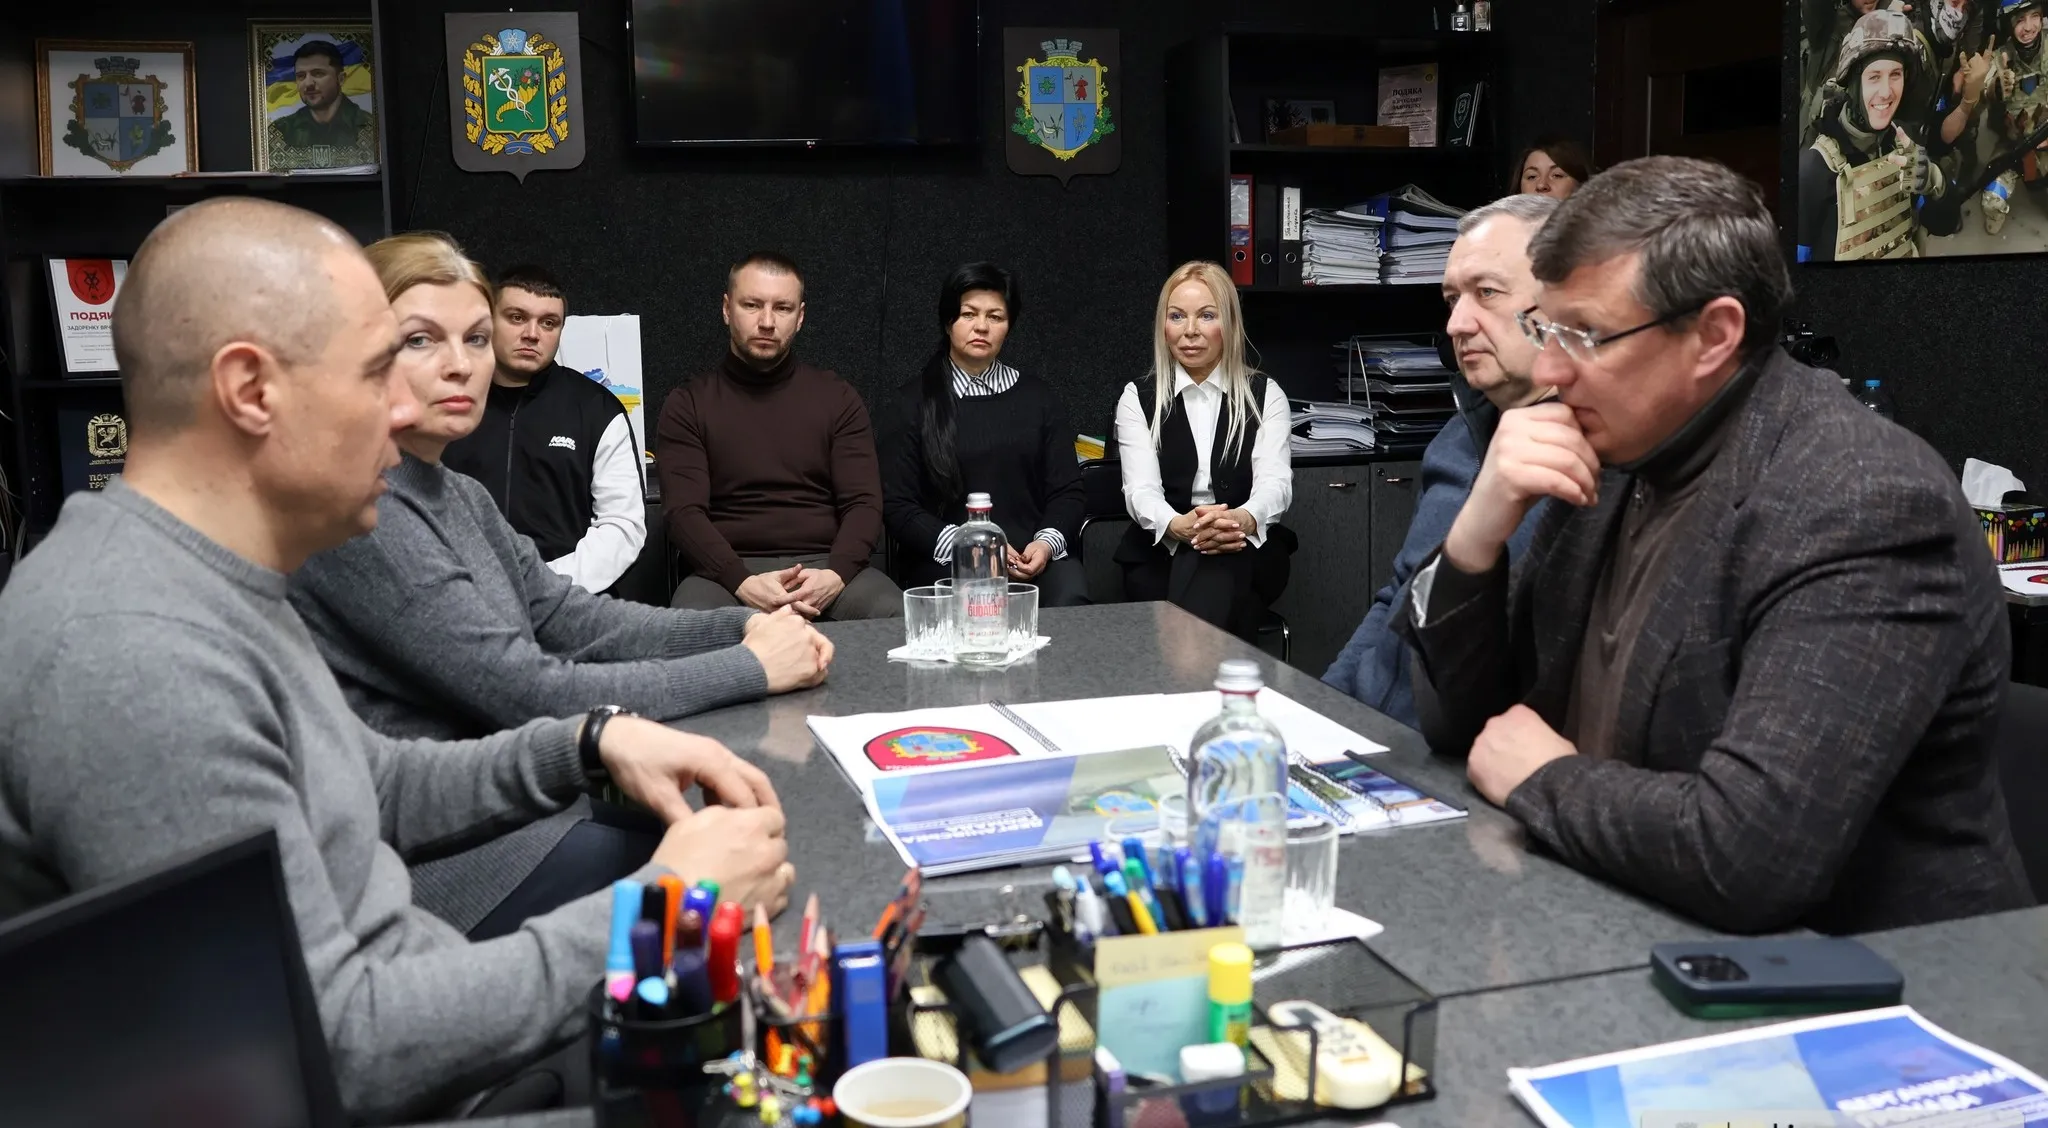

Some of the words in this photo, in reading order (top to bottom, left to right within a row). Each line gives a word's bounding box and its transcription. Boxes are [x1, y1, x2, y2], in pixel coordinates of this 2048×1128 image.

[1392, 87, 1423, 96] ПОДЯКА
[70, 312, 113, 321] ПОДЯК
[968, 593, 996, 605] WATER
